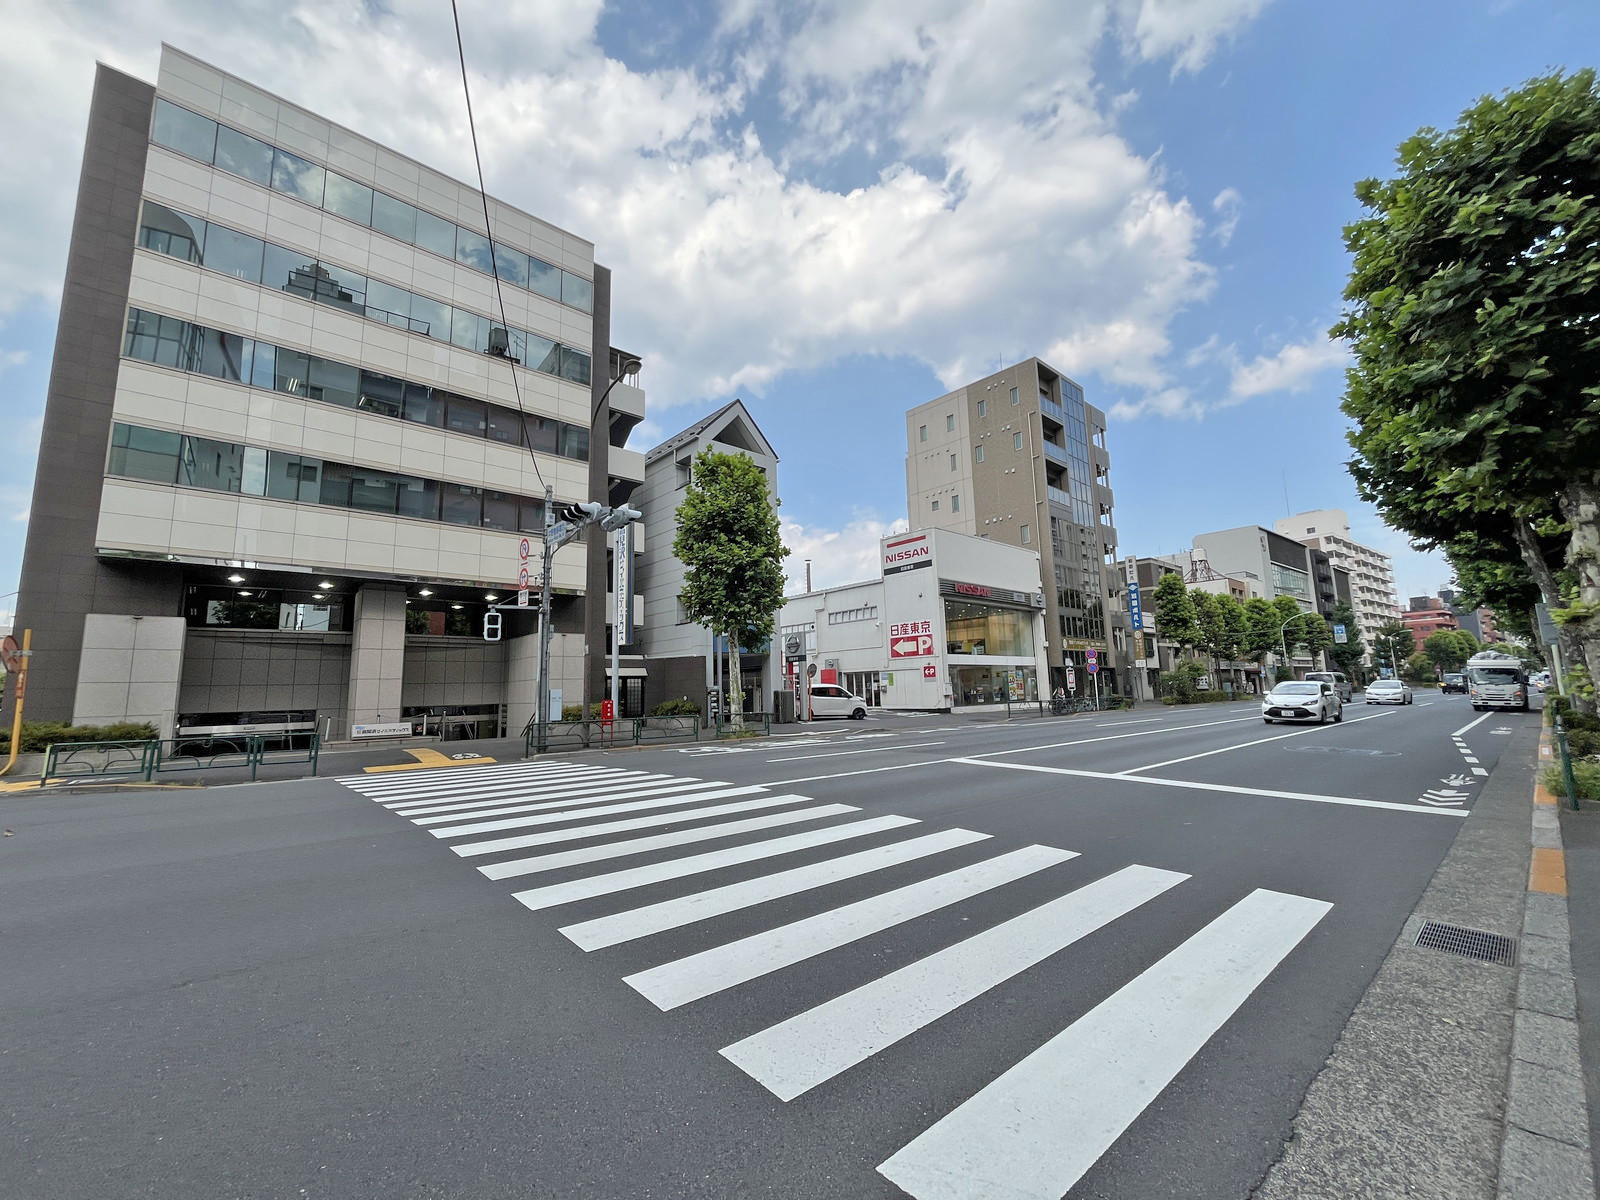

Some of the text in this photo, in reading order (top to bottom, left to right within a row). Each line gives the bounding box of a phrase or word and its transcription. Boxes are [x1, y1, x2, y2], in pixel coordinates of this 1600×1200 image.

[885, 546, 929, 563] NISSAN
[955, 583, 992, 597] NISSAN
[890, 621, 931, 636] 日産東京
[917, 636, 932, 655] P
